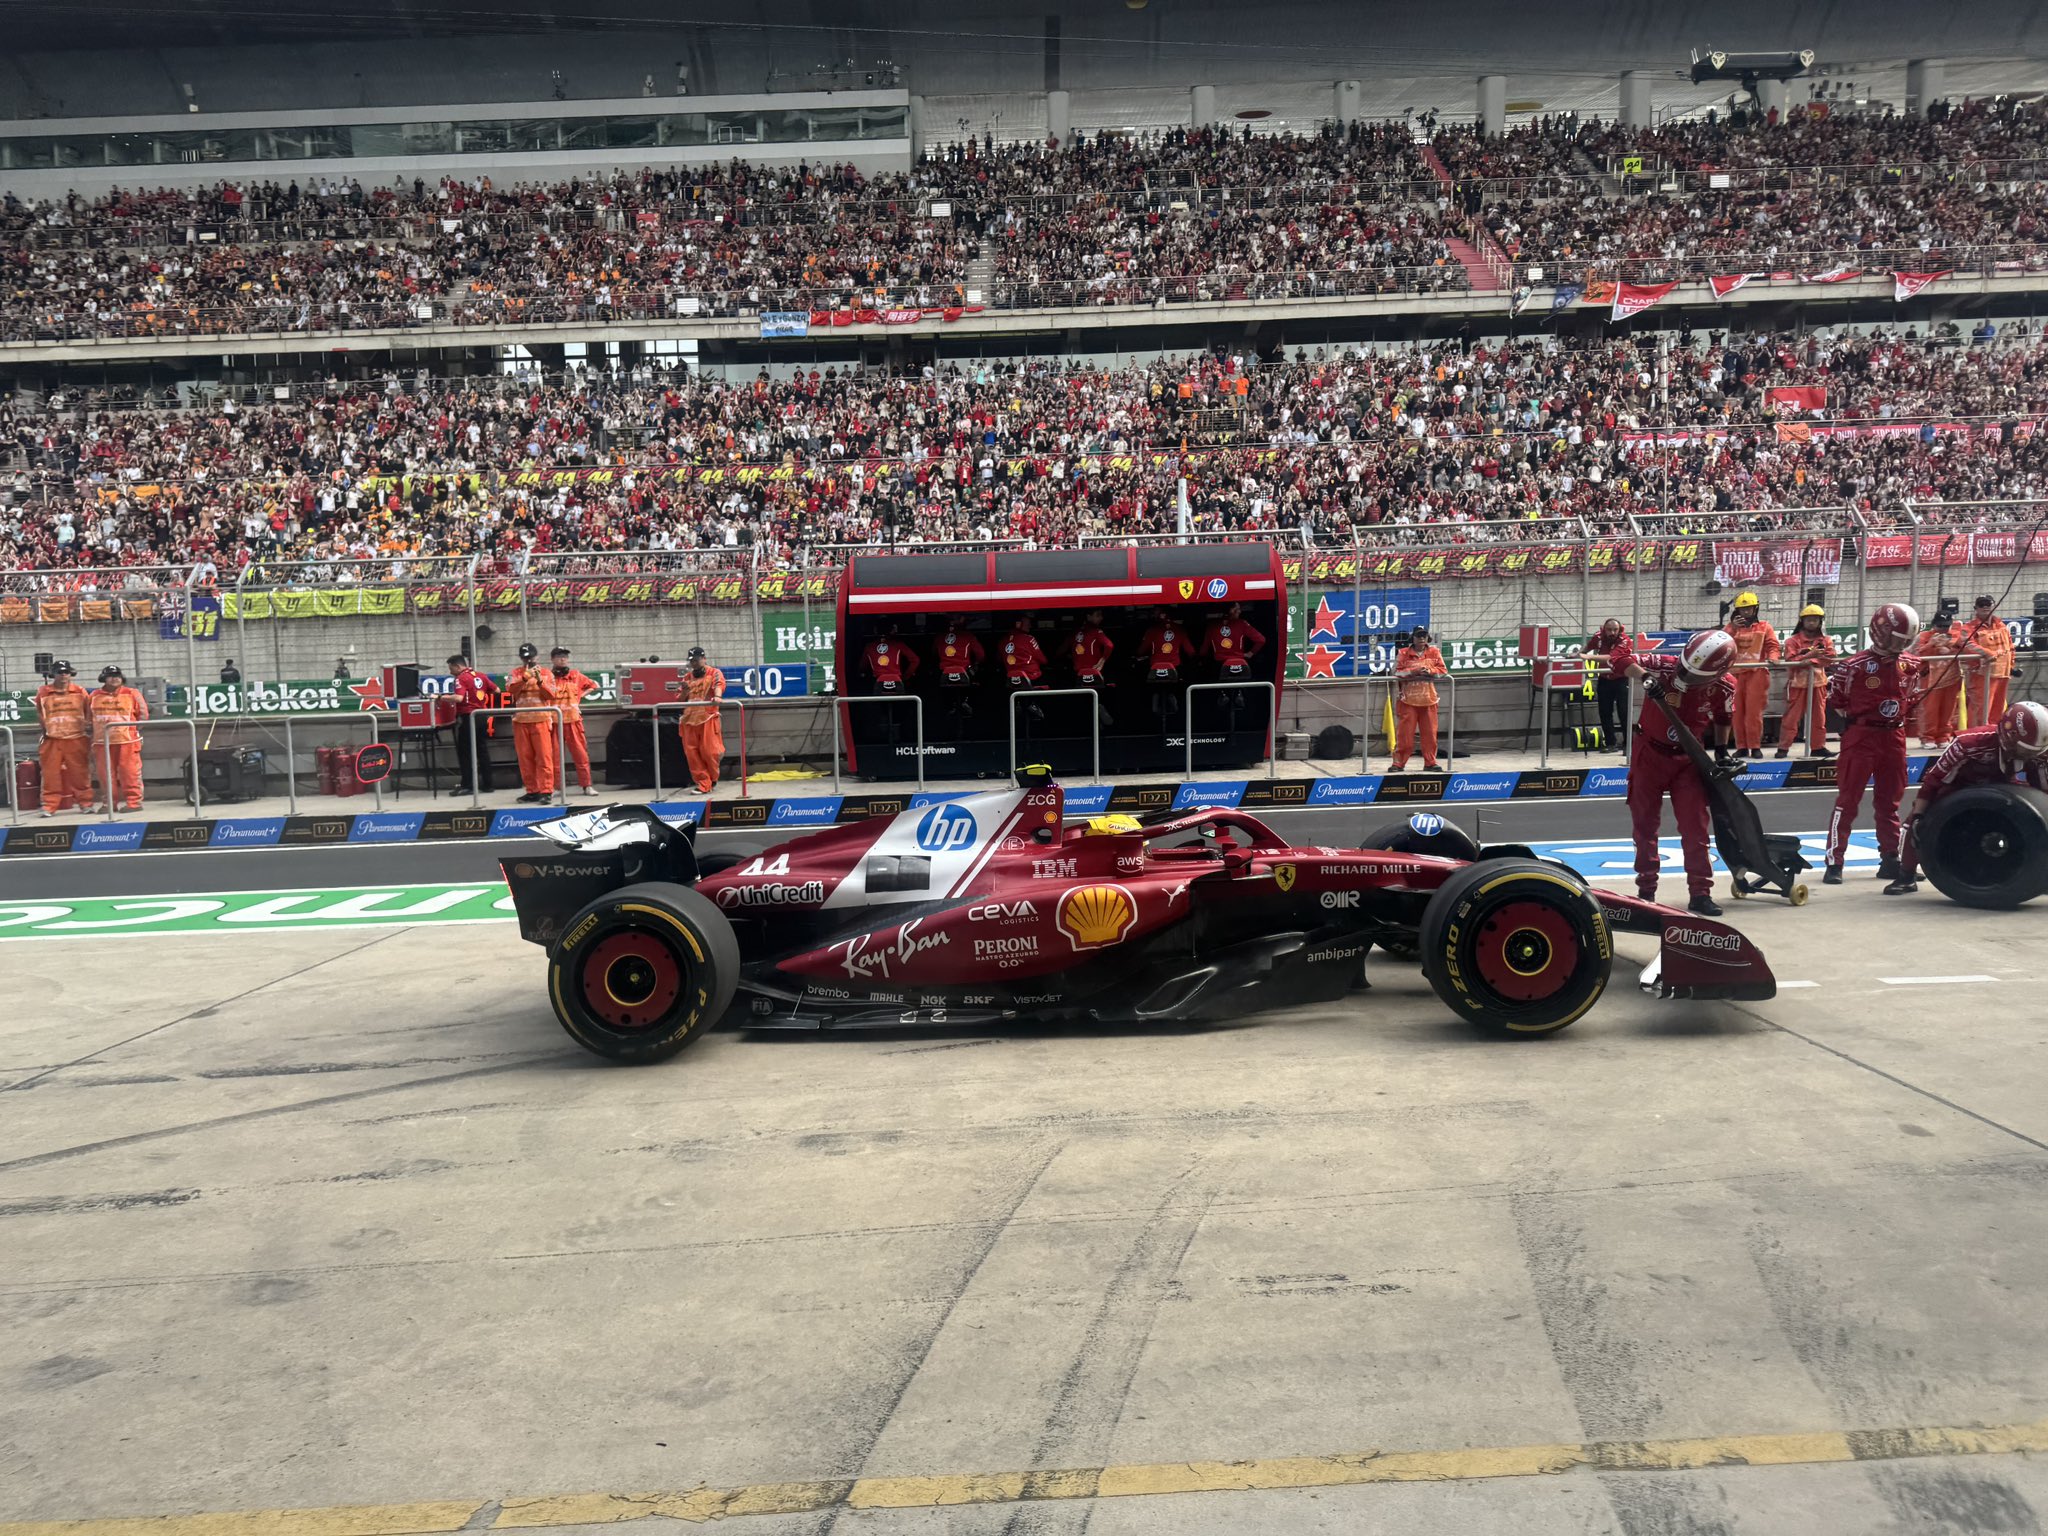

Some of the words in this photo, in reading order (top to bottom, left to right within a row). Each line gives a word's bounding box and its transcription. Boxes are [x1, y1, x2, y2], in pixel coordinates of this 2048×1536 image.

[1669, 545, 1698, 563] 44
[1211, 579, 1226, 598] hp
[1366, 605, 1399, 629] 0.0
[744, 668, 782, 695] 0.0
[1731, 769, 1783, 781] aramount+
[1318, 784, 1375, 798] Paramount+
[1412, 783, 1438, 793] 1923
[1452, 778, 1512, 793] Paramount+
[1549, 778, 1576, 789] 1923
[1143, 793, 1168, 803] 1923
[1181, 788, 1239, 803] Paramount+
[1277, 788, 1302, 797] 1923
[736, 809, 762, 819] 1923
[776, 804, 834, 818] Paramount+
[873, 804, 898, 813] 1923
[218, 824, 277, 840] Paramount+
[357, 819, 416, 835] Paramount+
[922, 803, 972, 851] hp
[1416, 813, 1441, 836] hp
[80, 830, 139, 846] Paramount+
[738, 853, 790, 876] 44
[1032, 858, 1078, 879] IBM
[1117, 856, 1144, 868] aws
[1321, 865, 1378, 875] RICHARD
[1382, 864, 1422, 874] MILLE
[533, 864, 610, 877] V-Power
[740, 881, 823, 905] UniCredit
[1000, 916, 1039, 925] LOGISTICS
[1604, 905, 1631, 921] redit
[1592, 913, 1610, 960] PIRELLI
[1680, 929, 1741, 951] UniCredit
[973, 936, 1038, 955] PERONI
[1307, 948, 1357, 963] ambipar
[1446, 924, 1468, 993] ZERO
[807, 984, 850, 999] brembo
[869, 992, 904, 1003] MAHLE
[920, 995, 946, 1005] NGK
[963, 995, 994, 1004] SKF
